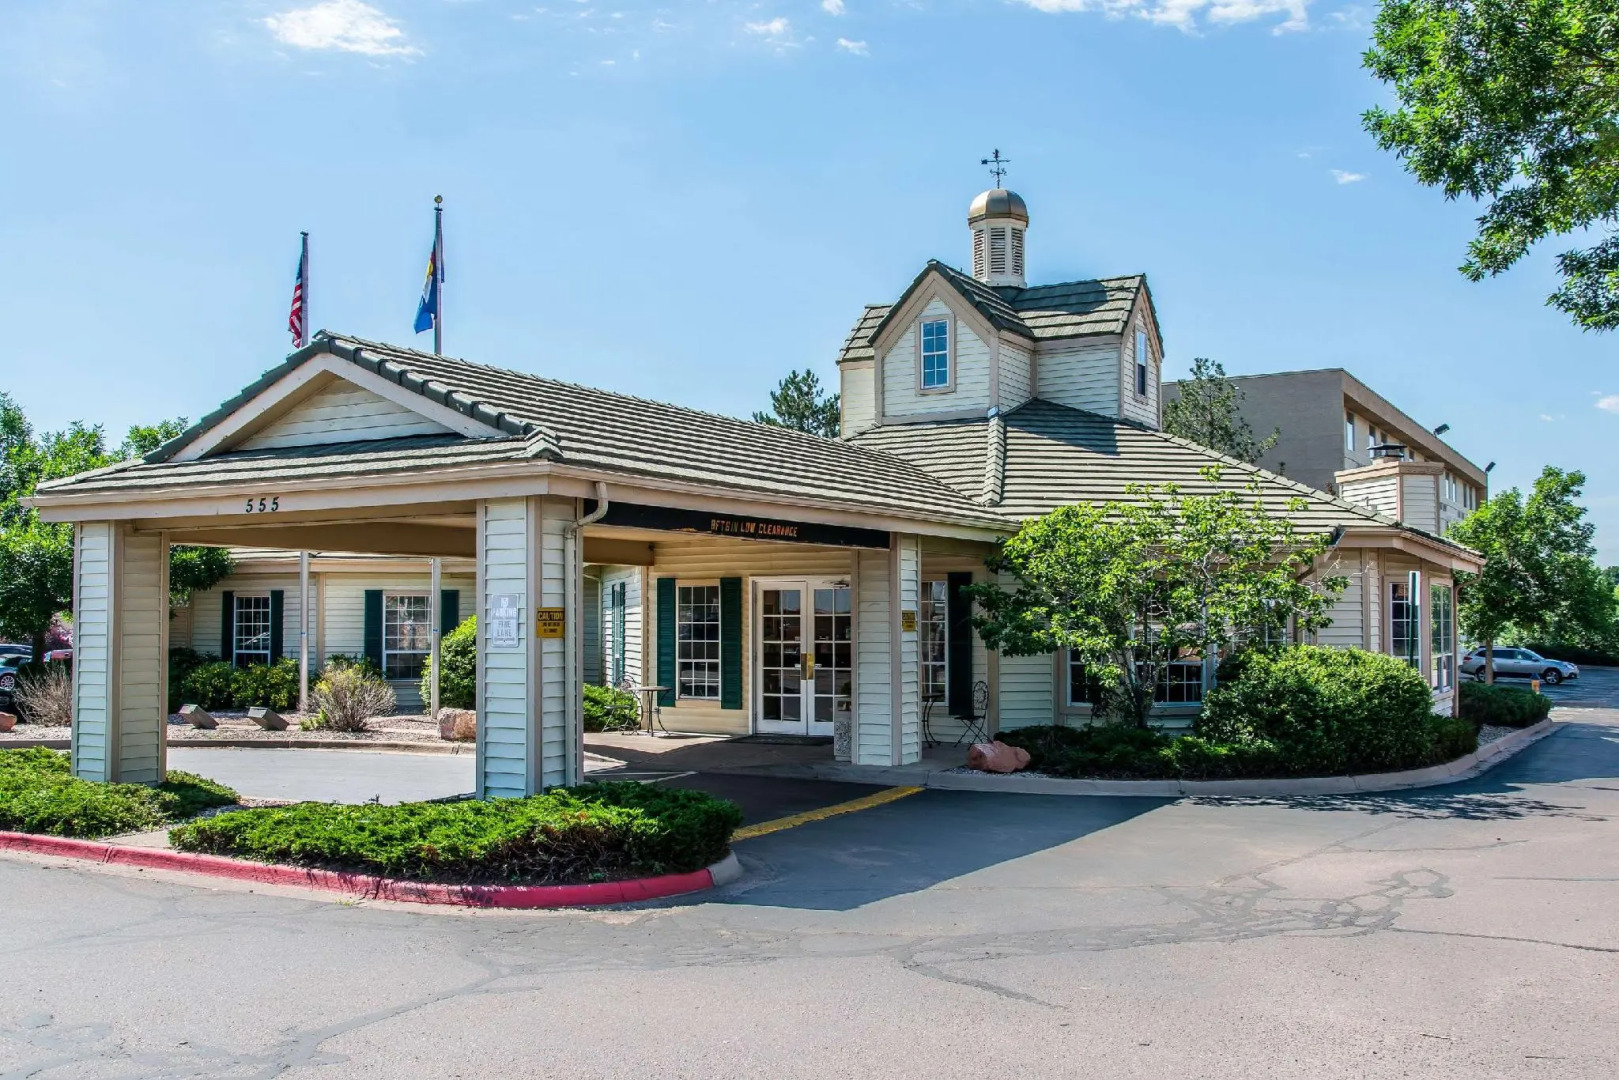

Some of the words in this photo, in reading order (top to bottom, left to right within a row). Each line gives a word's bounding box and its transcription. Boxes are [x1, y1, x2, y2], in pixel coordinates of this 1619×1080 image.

[245, 496, 280, 513] 555
[740, 521, 757, 533] LOW
[758, 523, 799, 537] CLEARANCE
[538, 611, 564, 621] CAUTION
